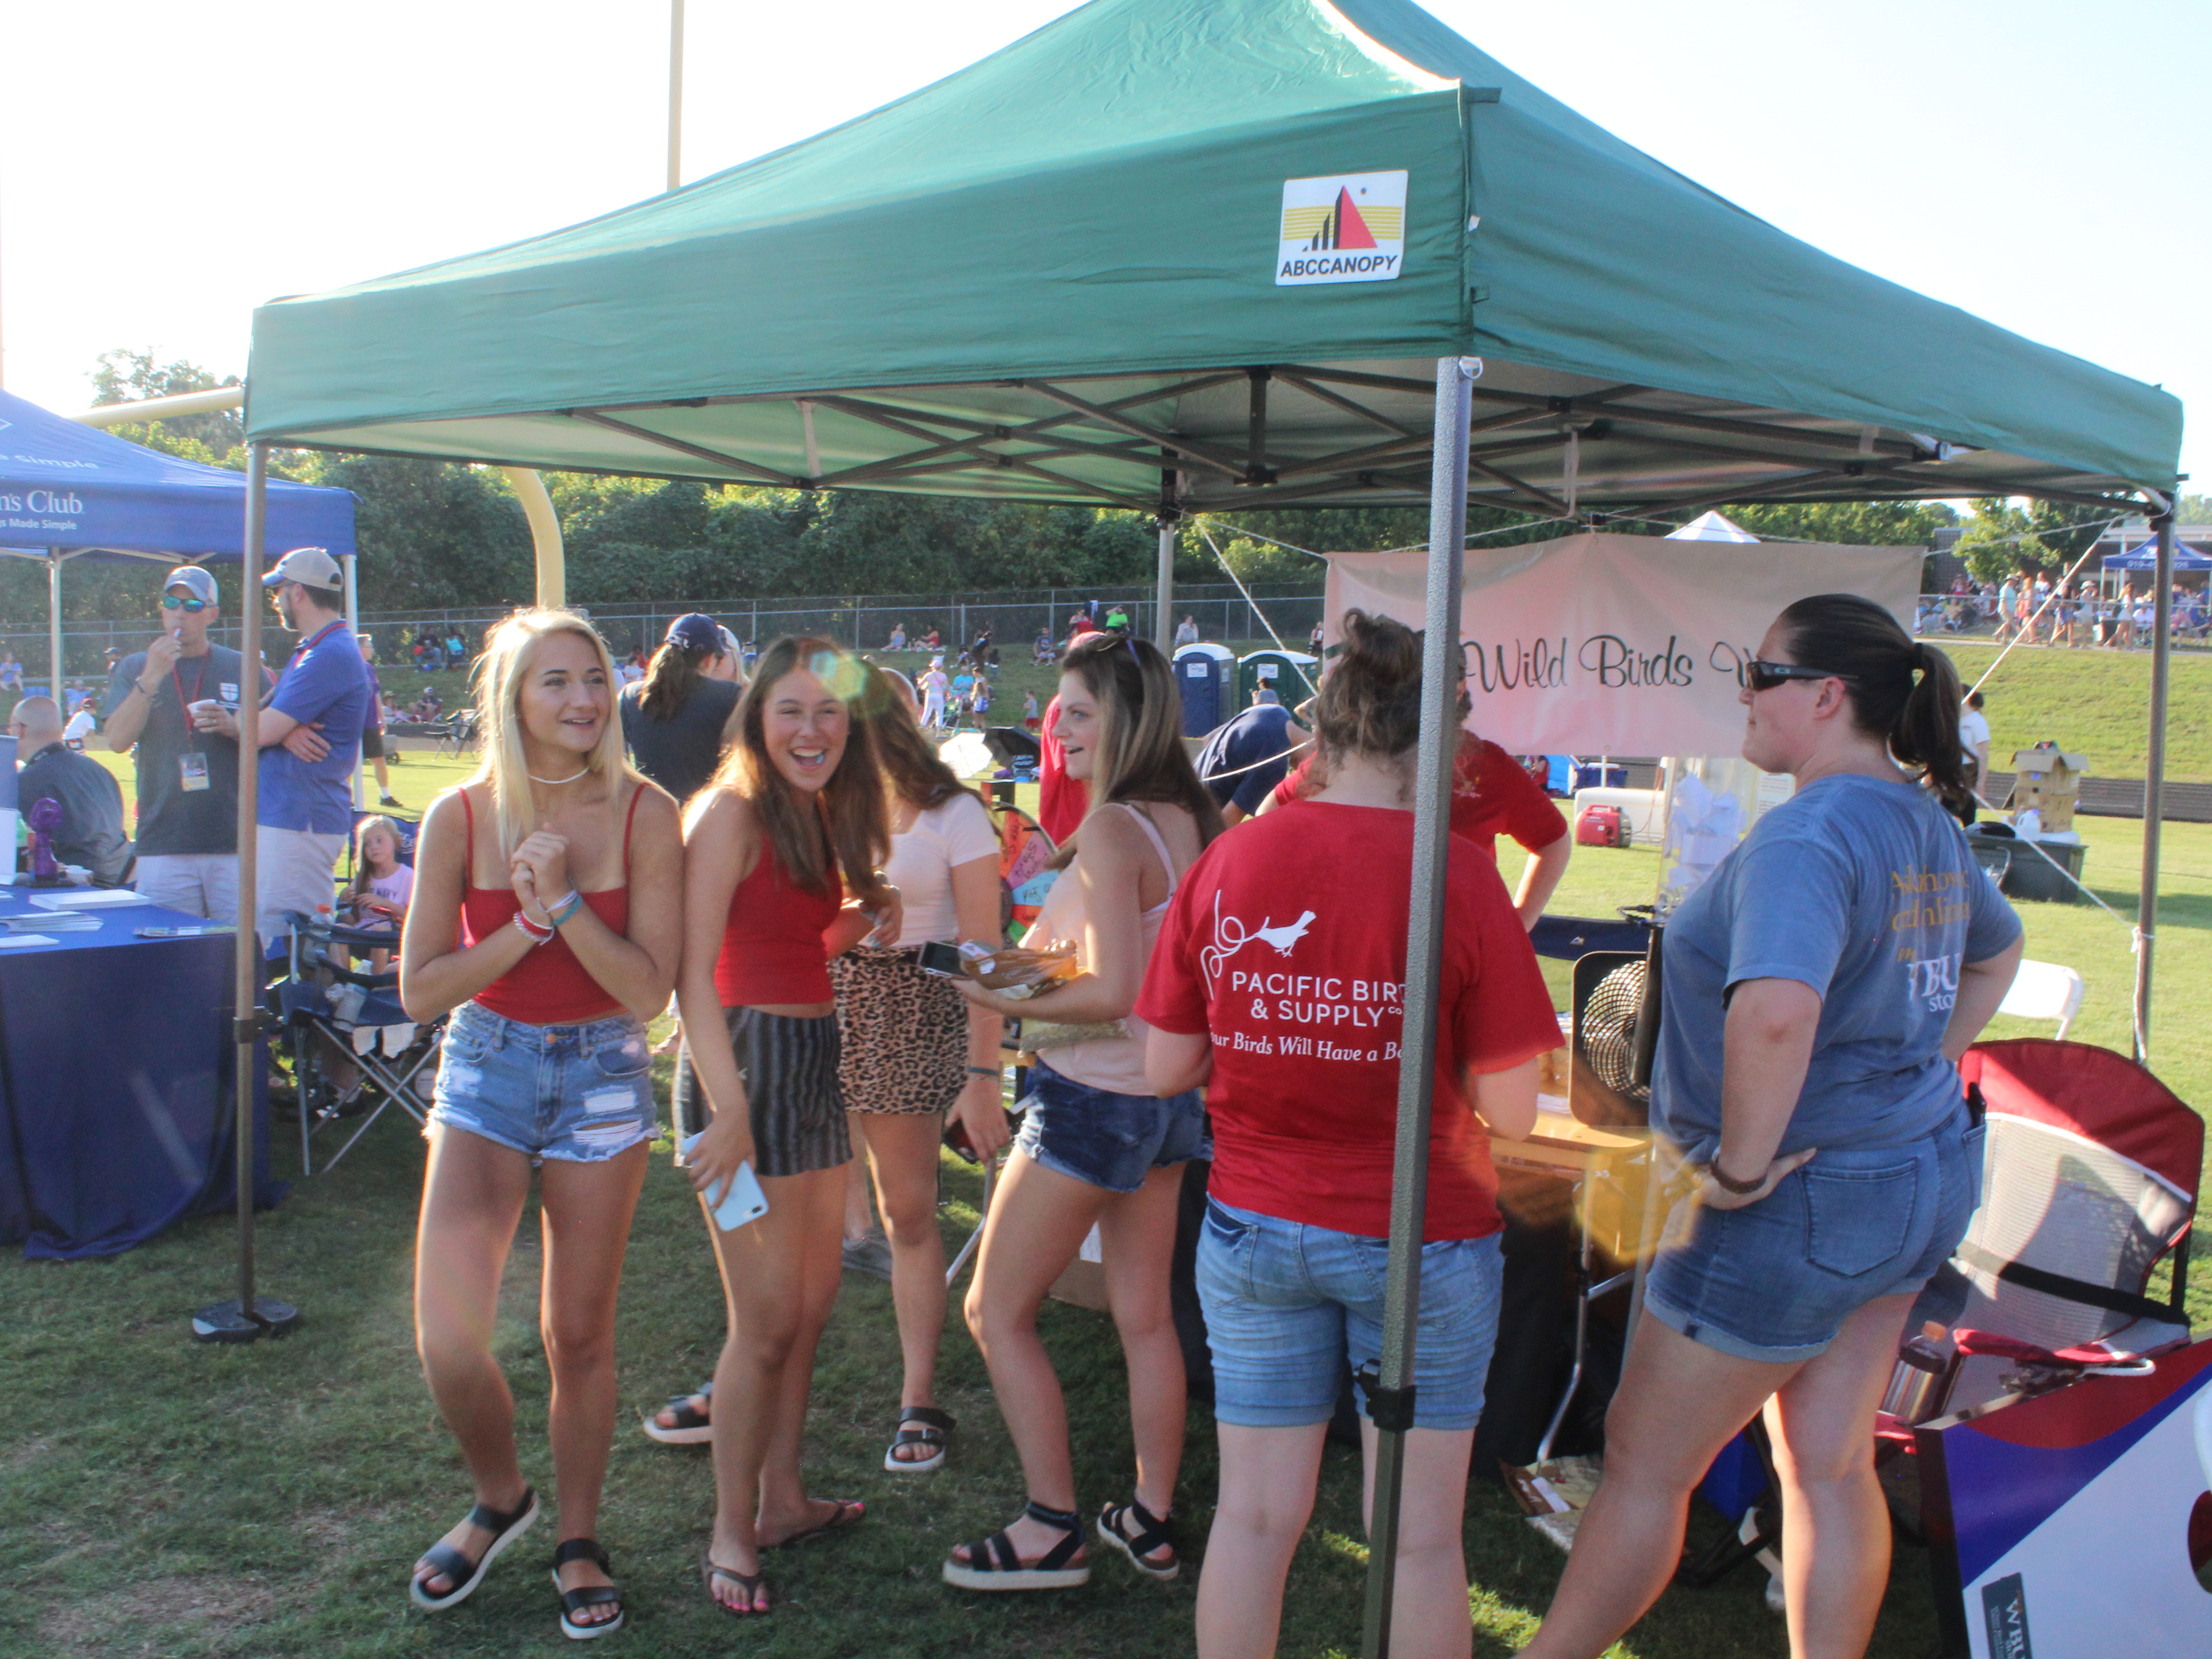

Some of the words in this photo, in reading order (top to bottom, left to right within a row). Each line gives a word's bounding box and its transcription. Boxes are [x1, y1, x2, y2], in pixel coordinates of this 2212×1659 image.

[1280, 254, 1398, 277] ABCCANOPY
[27, 490, 84, 514] Club
[9, 518, 39, 528] Made
[41, 519, 77, 531] Simple
[1463, 637, 1568, 693] Wild
[1580, 635, 1694, 688] Birds
[1232, 971, 1342, 1000] PACIFIC
[1250, 998, 1269, 1020] &
[1278, 1000, 1384, 1027] SUPPLY
[1232, 1032, 1273, 1055] Birds
[1277, 1035, 1312, 1056] Will
[1316, 1041, 1361, 1061] Have
[1367, 1050, 1377, 1061] a
